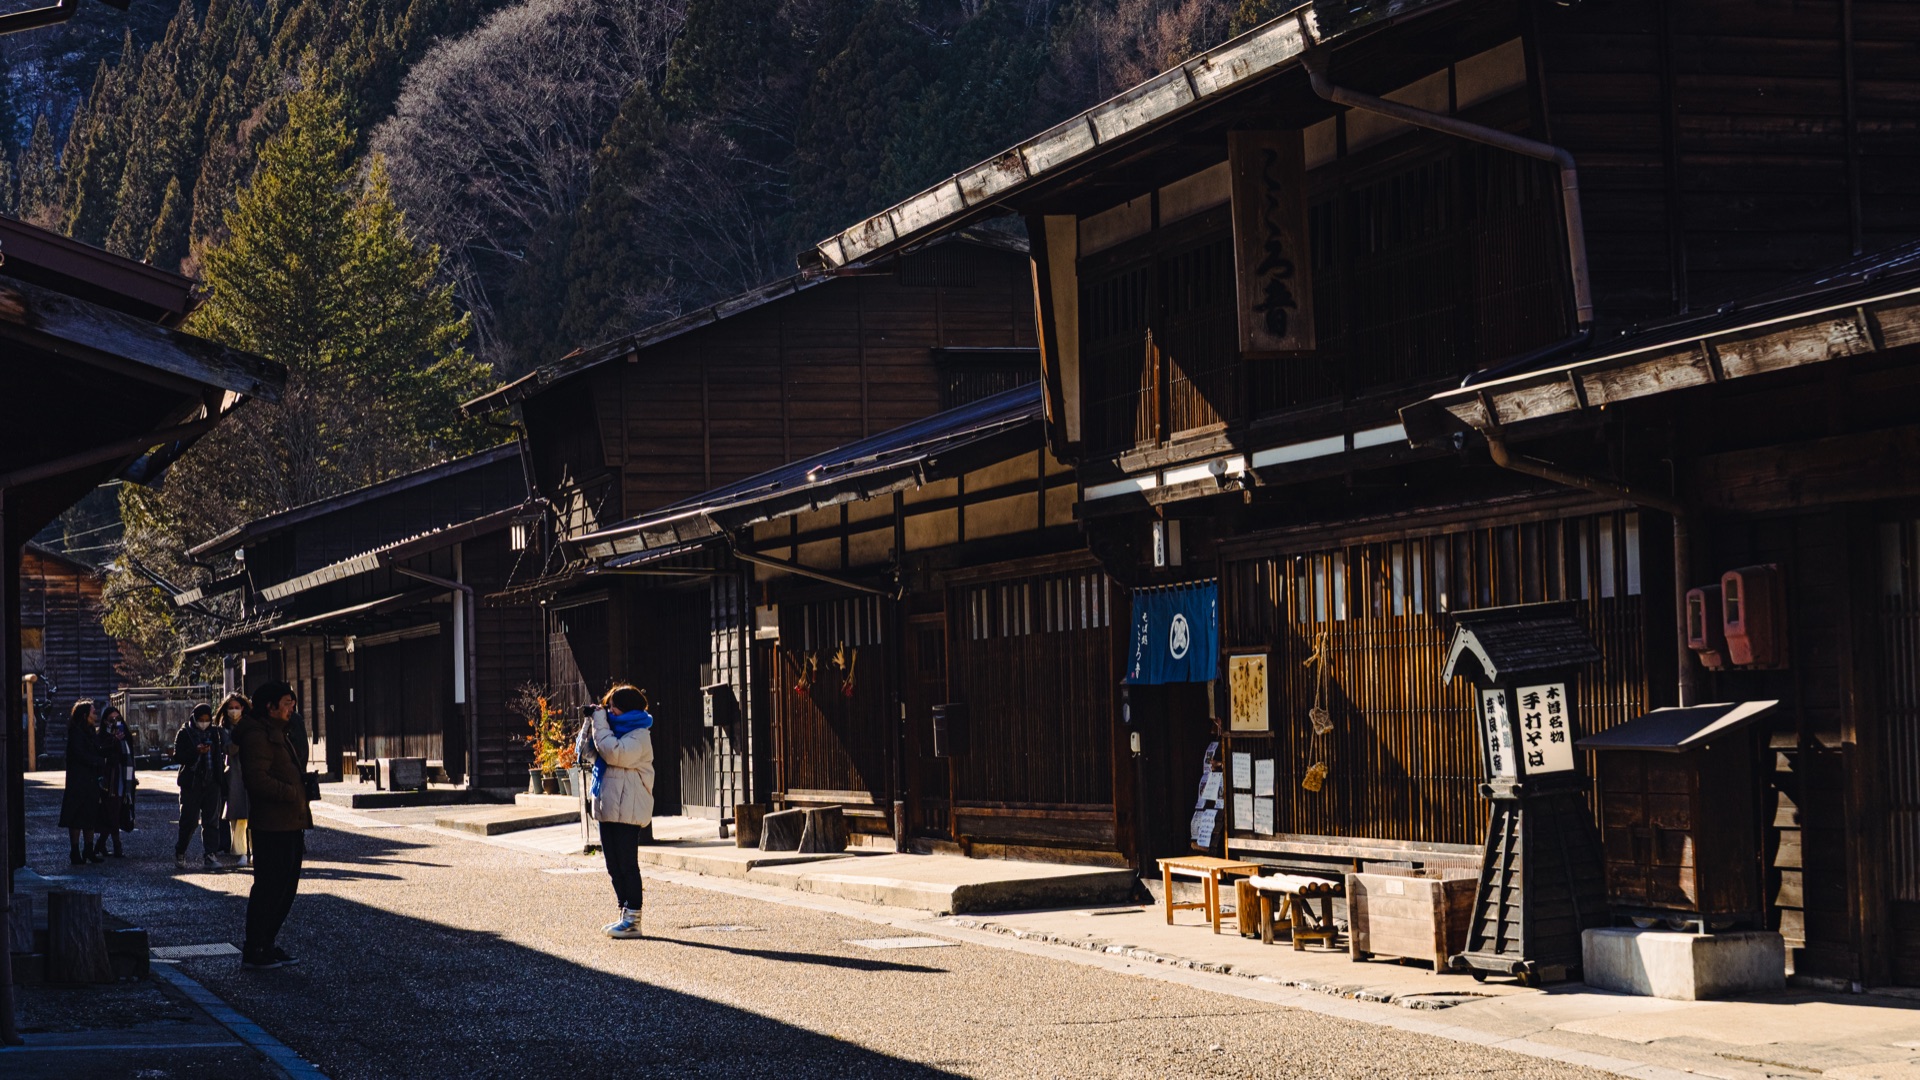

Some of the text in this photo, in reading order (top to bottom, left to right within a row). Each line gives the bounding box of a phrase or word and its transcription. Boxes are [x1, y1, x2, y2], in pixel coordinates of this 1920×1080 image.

[1486, 697, 1502, 771] 奈良井宿
[1522, 691, 1545, 767] 手打そば
